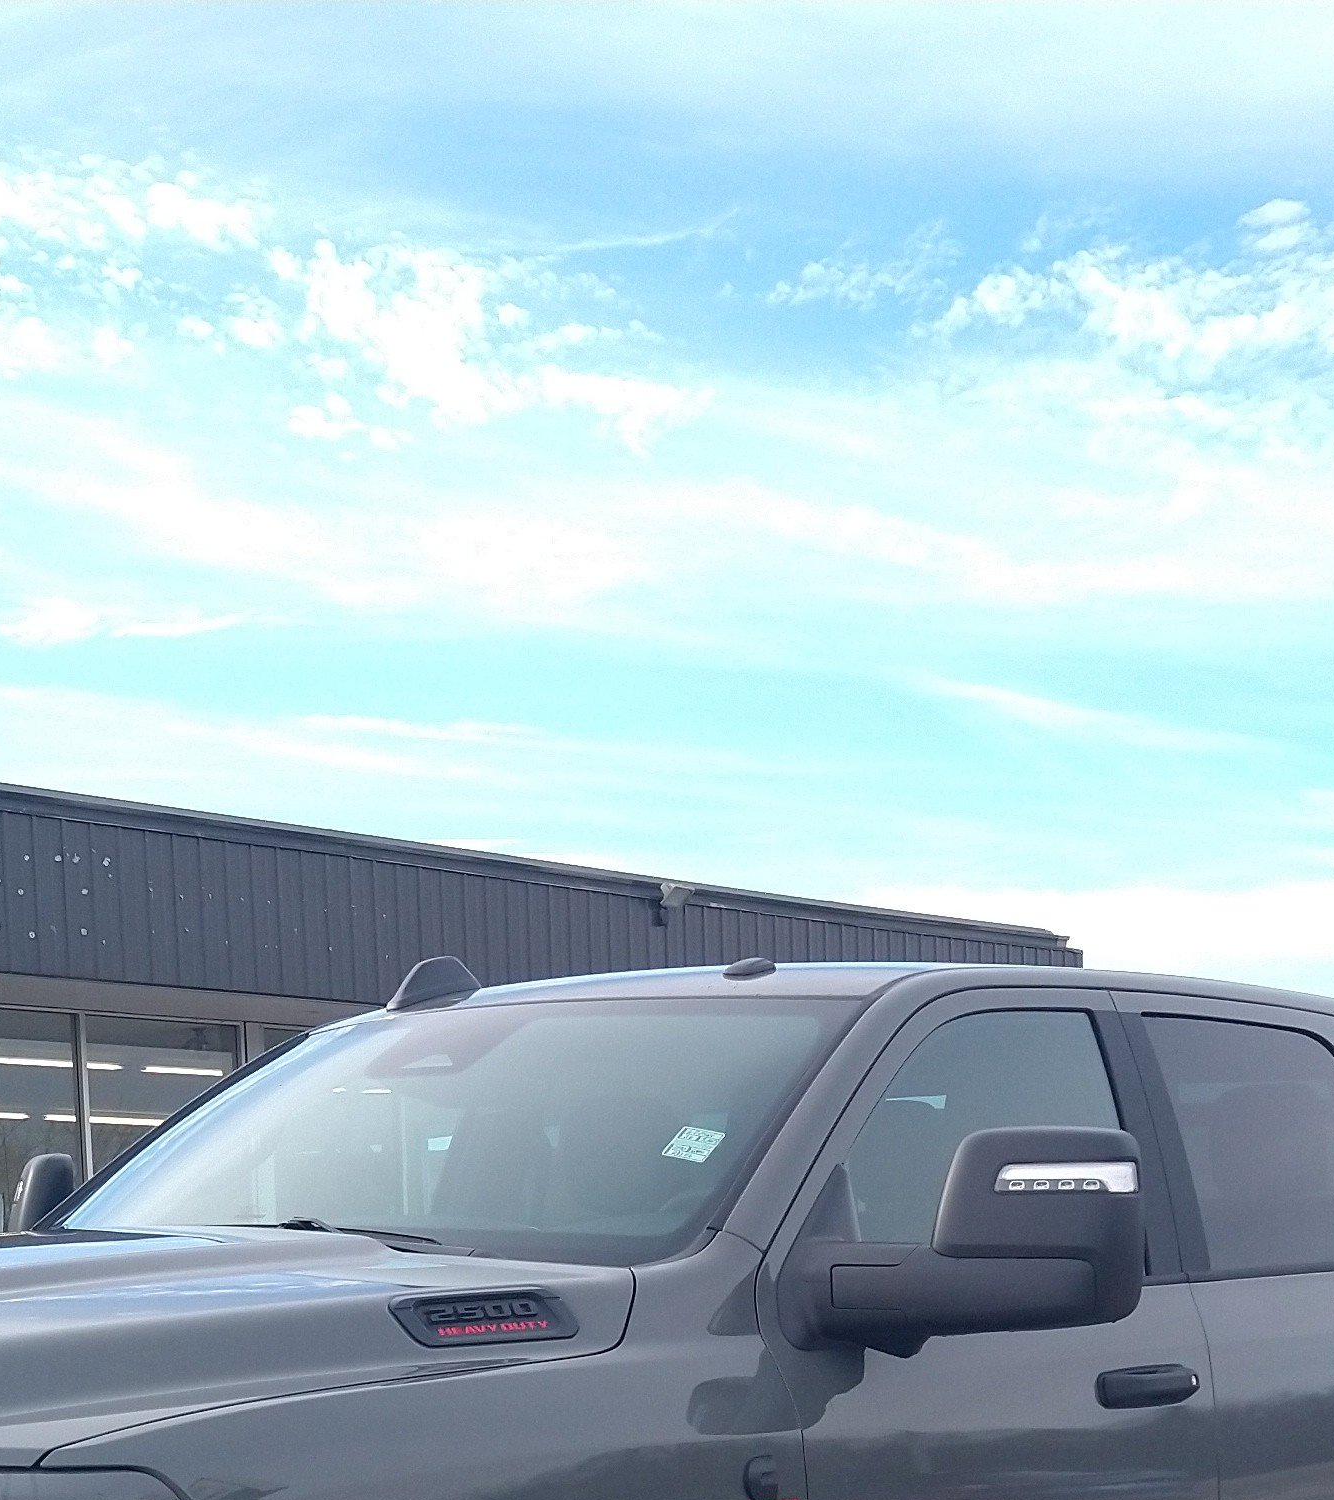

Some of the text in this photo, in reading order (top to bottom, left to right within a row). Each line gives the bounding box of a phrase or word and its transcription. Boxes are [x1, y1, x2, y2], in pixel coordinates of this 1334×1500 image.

[425, 1299, 539, 1323] 2500
[437, 1320, 548, 1337] HEAVY DUTY
